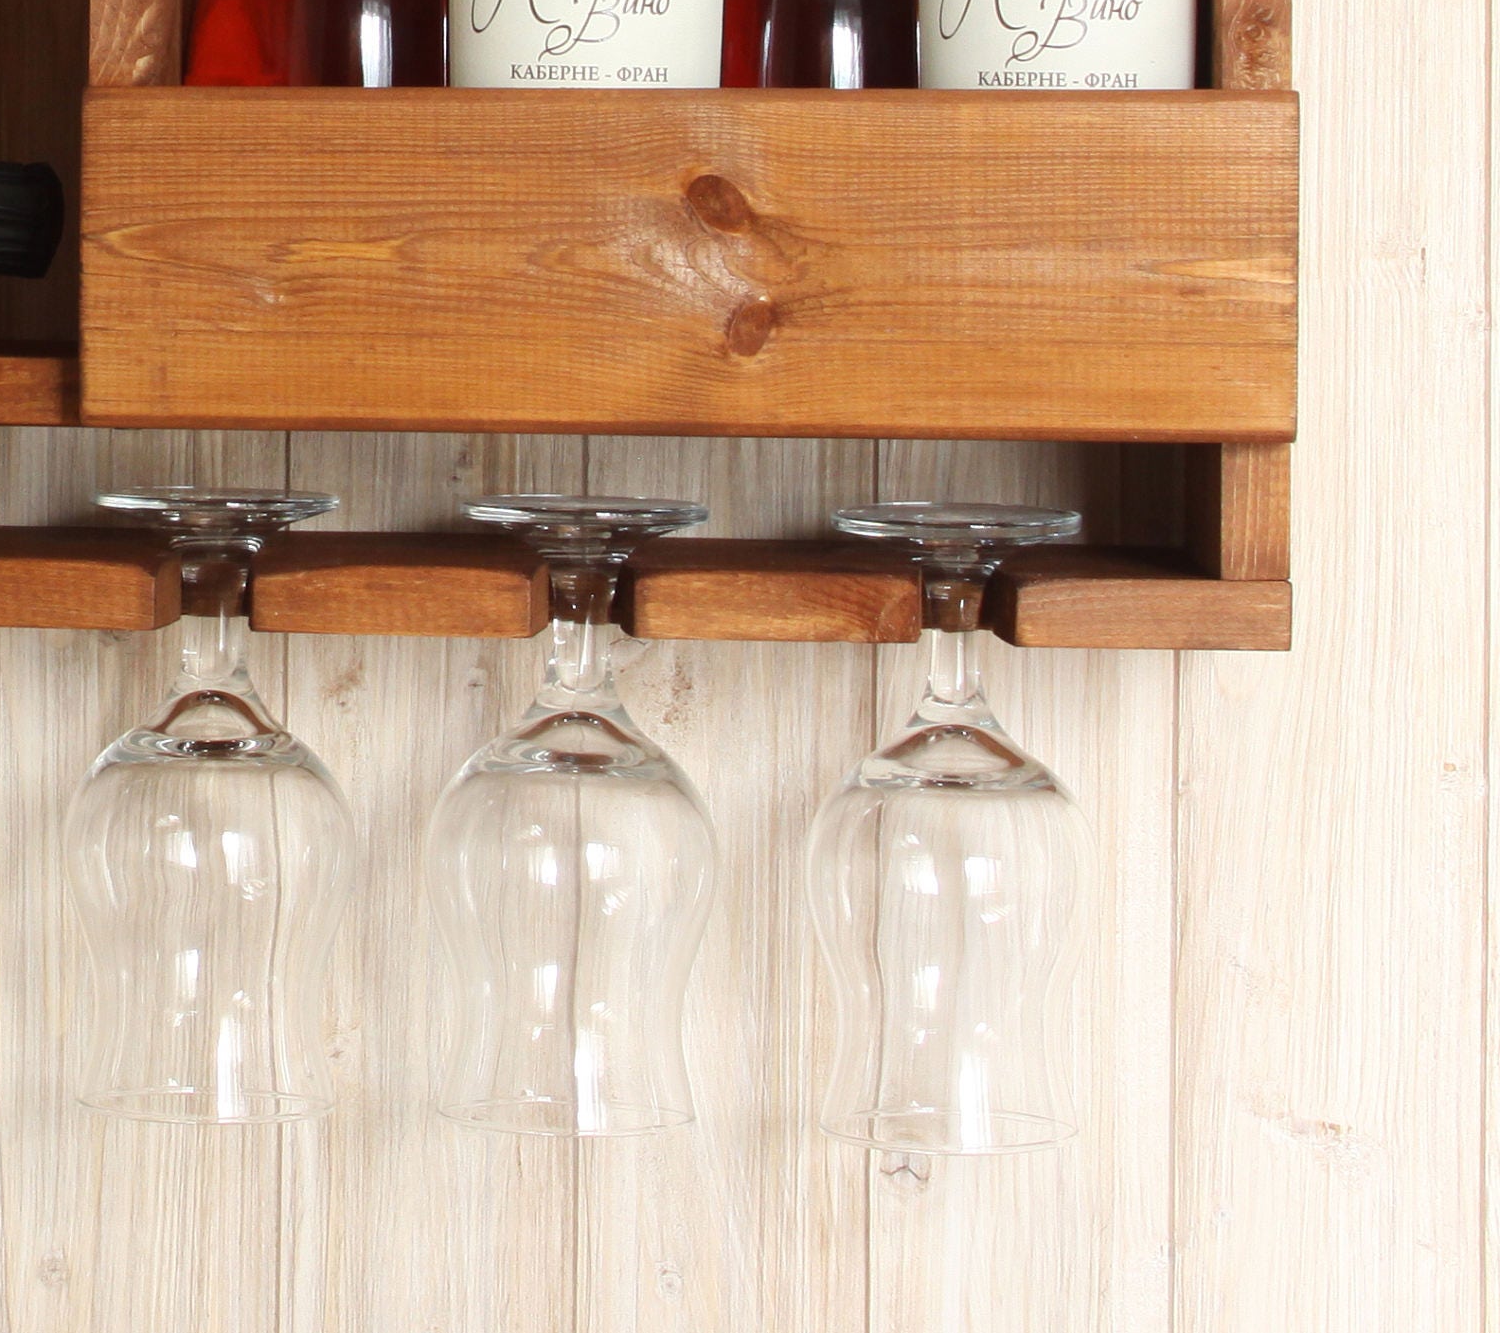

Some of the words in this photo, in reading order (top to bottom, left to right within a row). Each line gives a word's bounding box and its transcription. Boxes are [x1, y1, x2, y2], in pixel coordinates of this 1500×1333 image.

[510, 64, 599, 81] КАБЕРНЕ
[616, 65, 668, 82] ФРАН
[978, 71, 1067, 87] КАБЕРНЕ
[1084, 71, 1138, 88] ФРАН
